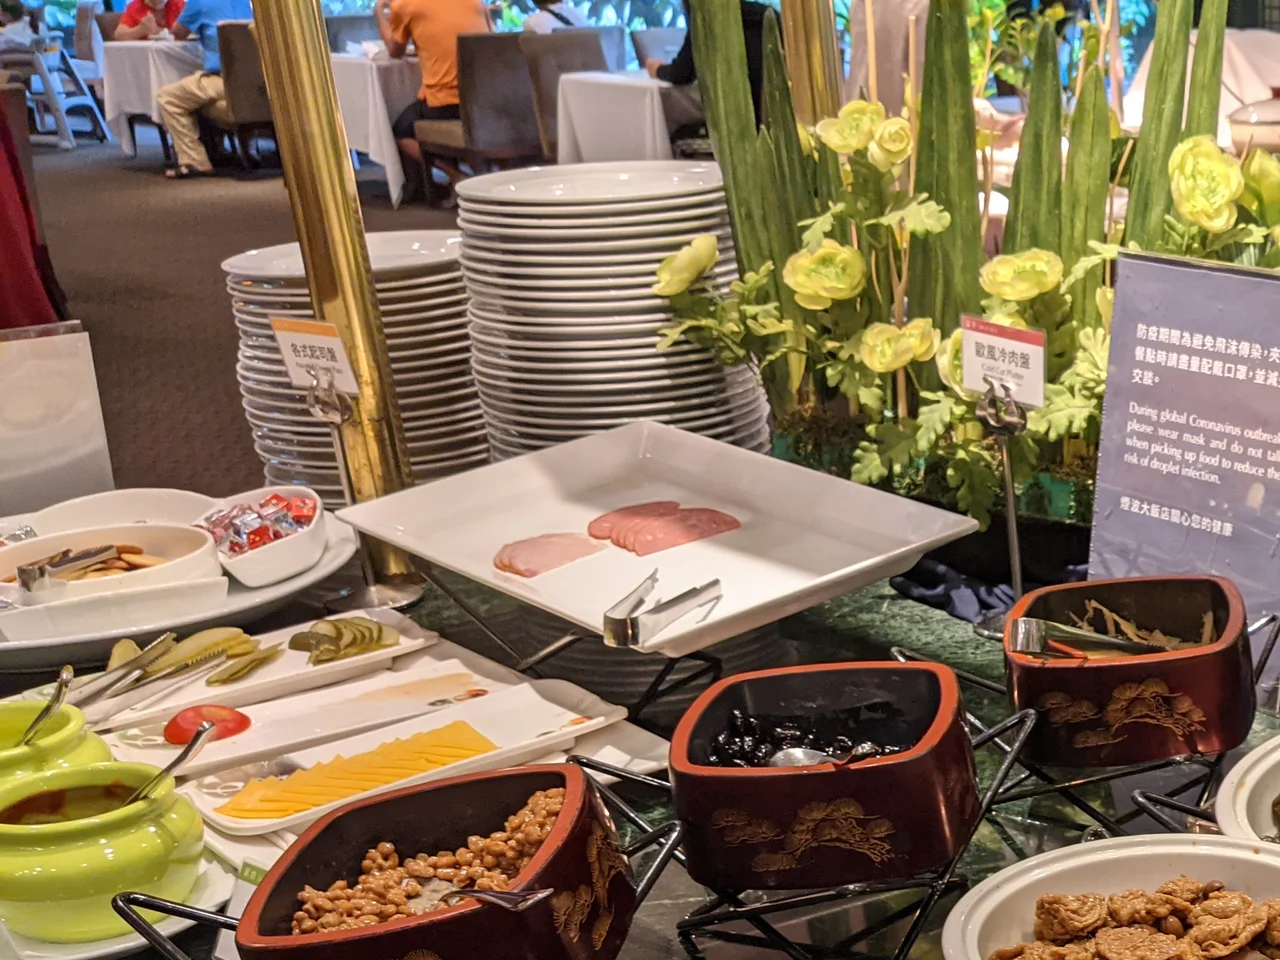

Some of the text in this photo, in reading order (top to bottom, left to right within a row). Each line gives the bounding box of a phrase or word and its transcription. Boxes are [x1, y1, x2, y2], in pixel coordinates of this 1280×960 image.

[1129, 401, 1157, 421] During
[1160, 408, 1187, 424] global
[1189, 414, 1241, 436] Coronavirus
[1125, 436, 1149, 450] when
[1151, 442, 1182, 461] picking
[1184, 450, 1196, 464] up
[1199, 451, 1220, 466] food
[1221, 457, 1231, 469] to
[1233, 461, 1265, 477] reduce
[1127, 418, 1154, 435] please
[1157, 427, 1179, 440] wear
[1182, 432, 1205, 446] mask
[1209, 438, 1226, 450] and
[1231, 441, 1243, 454] do
[1247, 447, 1263, 459] not
[1124, 452, 1221, 484] risk of droplet infection.
